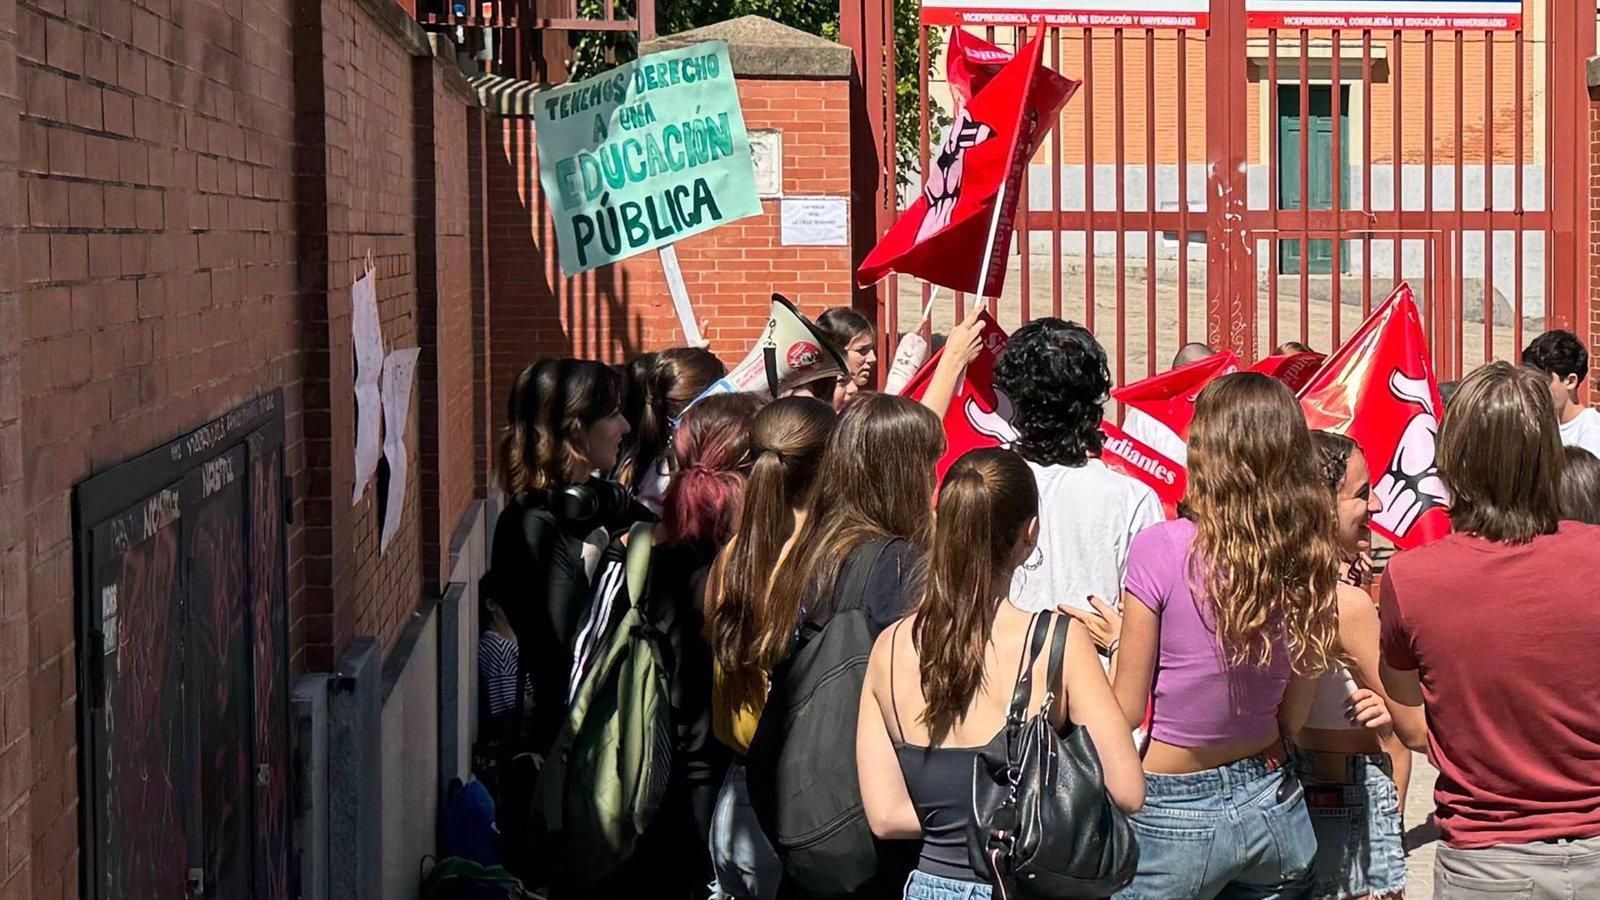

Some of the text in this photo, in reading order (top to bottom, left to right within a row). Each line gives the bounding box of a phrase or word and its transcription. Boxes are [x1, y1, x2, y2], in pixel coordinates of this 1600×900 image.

[1078, 14, 1089, 25] DE
[1089, 13, 1132, 26] EDUCACIÓN
[1140, 15, 1197, 27] UNIVERSIDADES
[1404, 16, 1447, 28] EDUCACIÓN
[545, 53, 720, 121] TENEMOS DERECHO
[593, 101, 657, 144] A UNA
[556, 105, 734, 211] EDUCACIÓN
[572, 177, 723, 267] PÚBLICA
